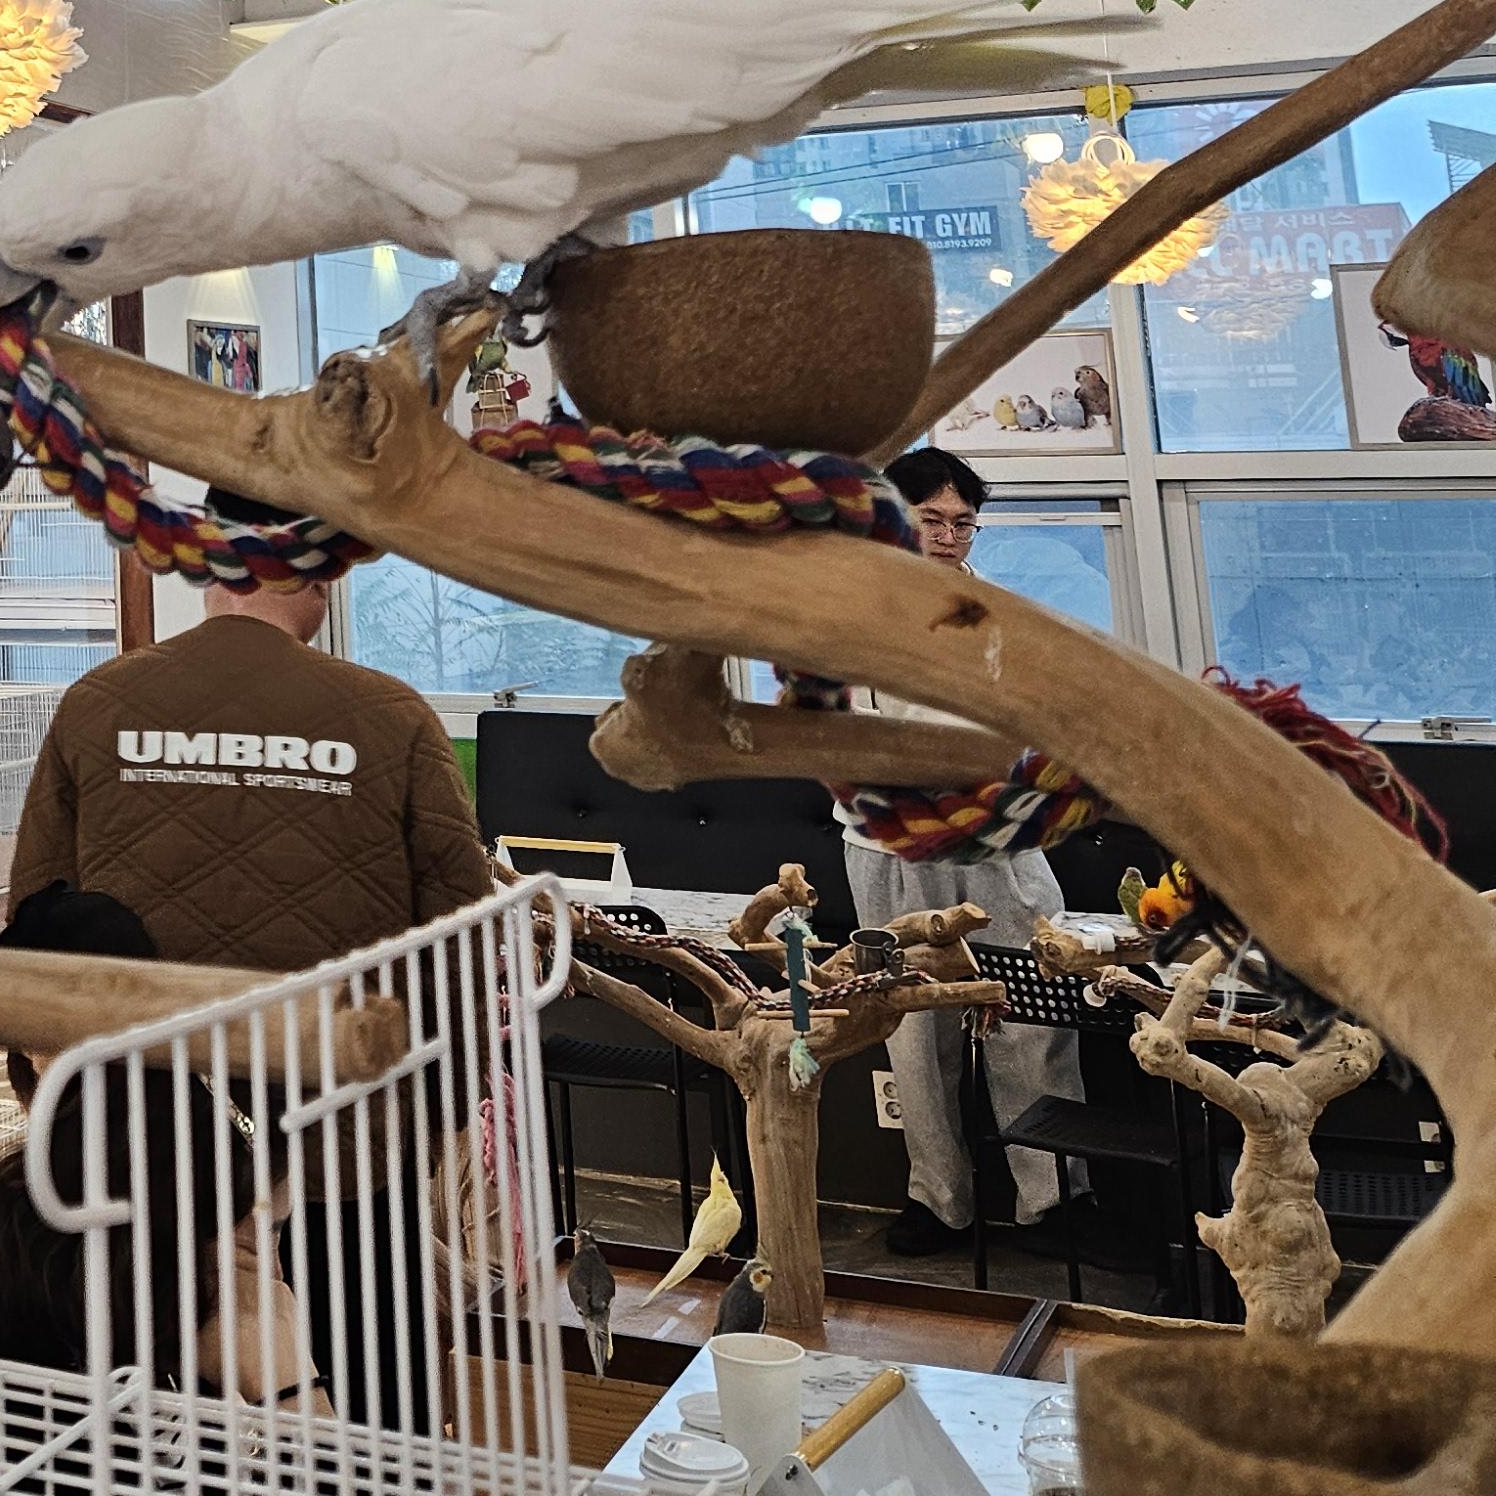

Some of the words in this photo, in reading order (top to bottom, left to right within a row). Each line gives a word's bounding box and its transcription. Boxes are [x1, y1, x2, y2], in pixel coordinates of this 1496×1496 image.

[935, 212, 992, 237] GYM
[1275, 212, 1354, 230] 서비스
[117, 730, 358, 775] UMBRO
